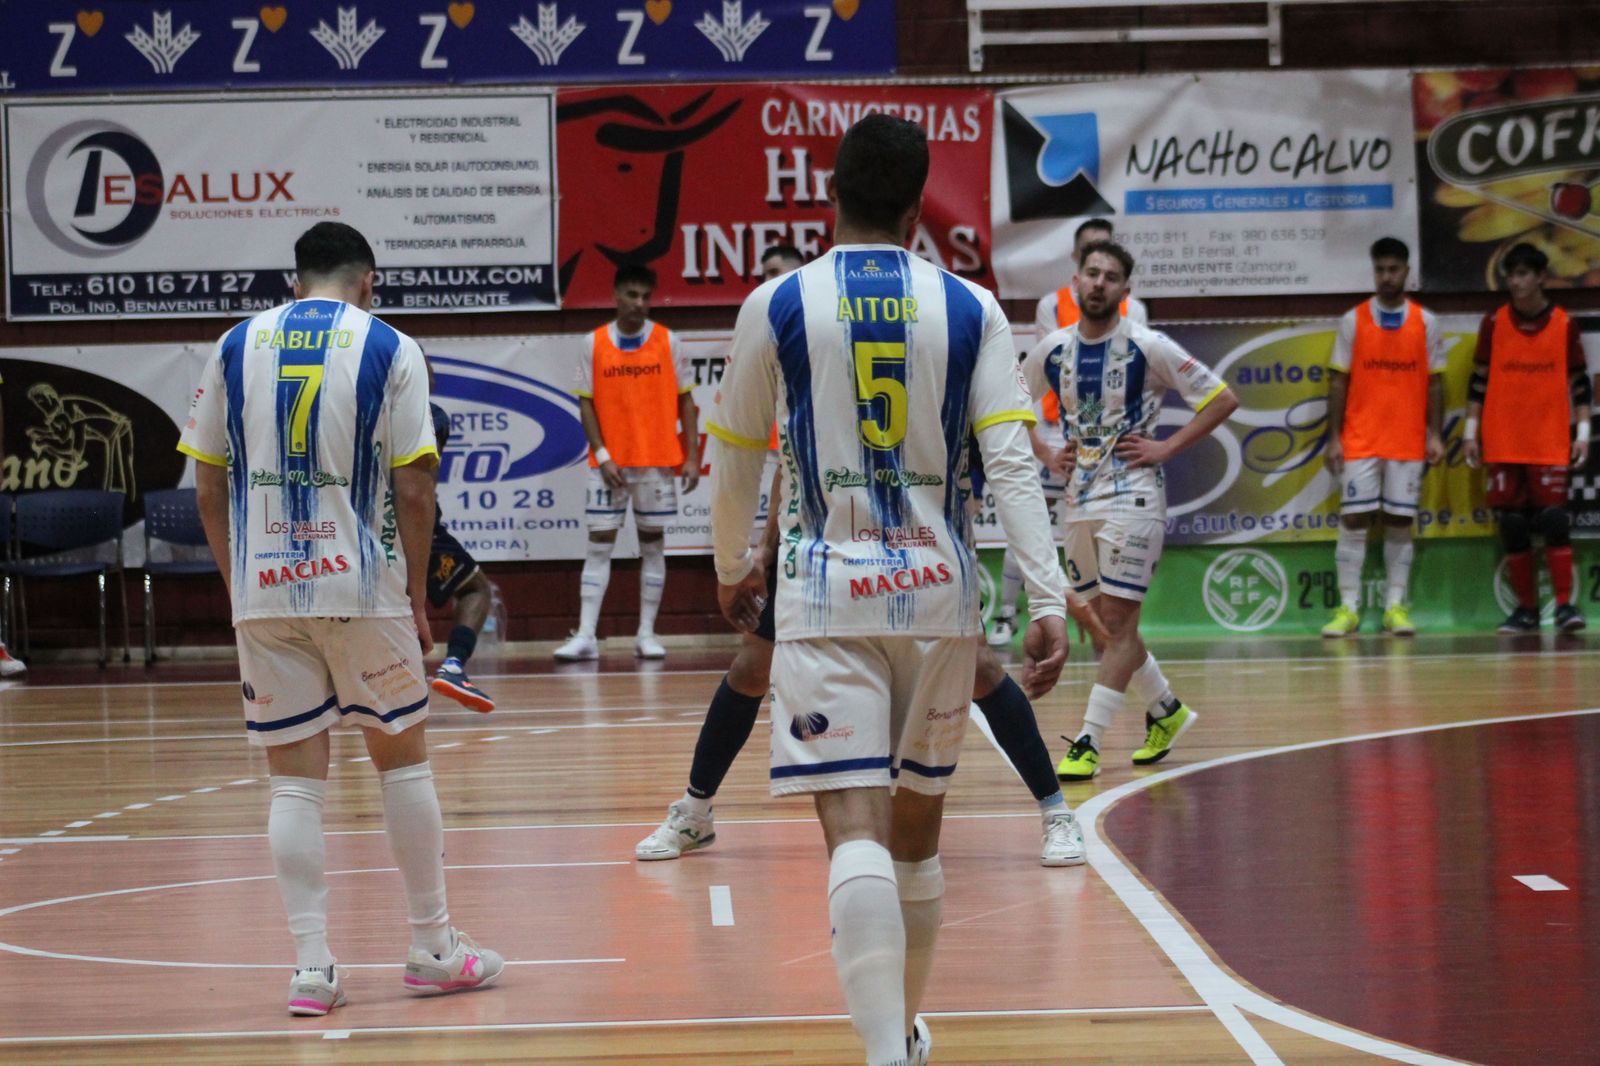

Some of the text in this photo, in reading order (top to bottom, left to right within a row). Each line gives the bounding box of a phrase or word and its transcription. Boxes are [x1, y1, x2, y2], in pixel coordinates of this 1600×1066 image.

[420, 15, 448, 68] Z
[616, 11, 645, 64] Z
[804, 7, 832, 61] Z
[49, 24, 77, 77] Z
[231, 19, 260, 72] Z
[384, 116, 521, 129] ELECTRICIDAD INDUSTRIAL
[410, 132, 487, 144] Y RESIDENCIAL
[415, 161, 448, 172] SOLAR
[1125, 129, 1392, 182] NACHO CALVO
[416, 187, 429, 198] DE
[433, 187, 477, 198] CALIDAD
[481, 186, 493, 197] DE
[170, 208, 253, 220] SOLUCIONES
[413, 214, 496, 225] AUTOMATISMOS
[461, 237, 526, 249] INFRARROJA
[1151, 262, 1233, 275] BENAVENTE
[87, 275, 136, 295] 610
[146, 274, 175, 294] 16
[181, 273, 210, 294] 71
[221, 272, 255, 293] 27
[124, 299, 217, 313] BENAVENTE
[403, 293, 510, 307] BENAVENTE
[837, 297, 919, 322] AITOR
[255, 329, 353, 350] PABLITO
[604, 363, 661, 378] uhlsport
[852, 341, 908, 451] 5
[277, 364, 324, 457] 7
[451, 411, 508, 432] RTES
[457, 488, 555, 510] 10 28
[265, 493, 336, 534] LOS VALLES
[851, 496, 936, 542] LOS VALLES
[464, 539, 529, 551] MORA)
[886, 540, 937, 549] RESTAURANTE
[259, 555, 349, 588] MACIAS
[842, 557, 903, 566] CHAPISTERIA
[850, 563, 951, 598] MACIAS
[460, 953, 479, 976] K
